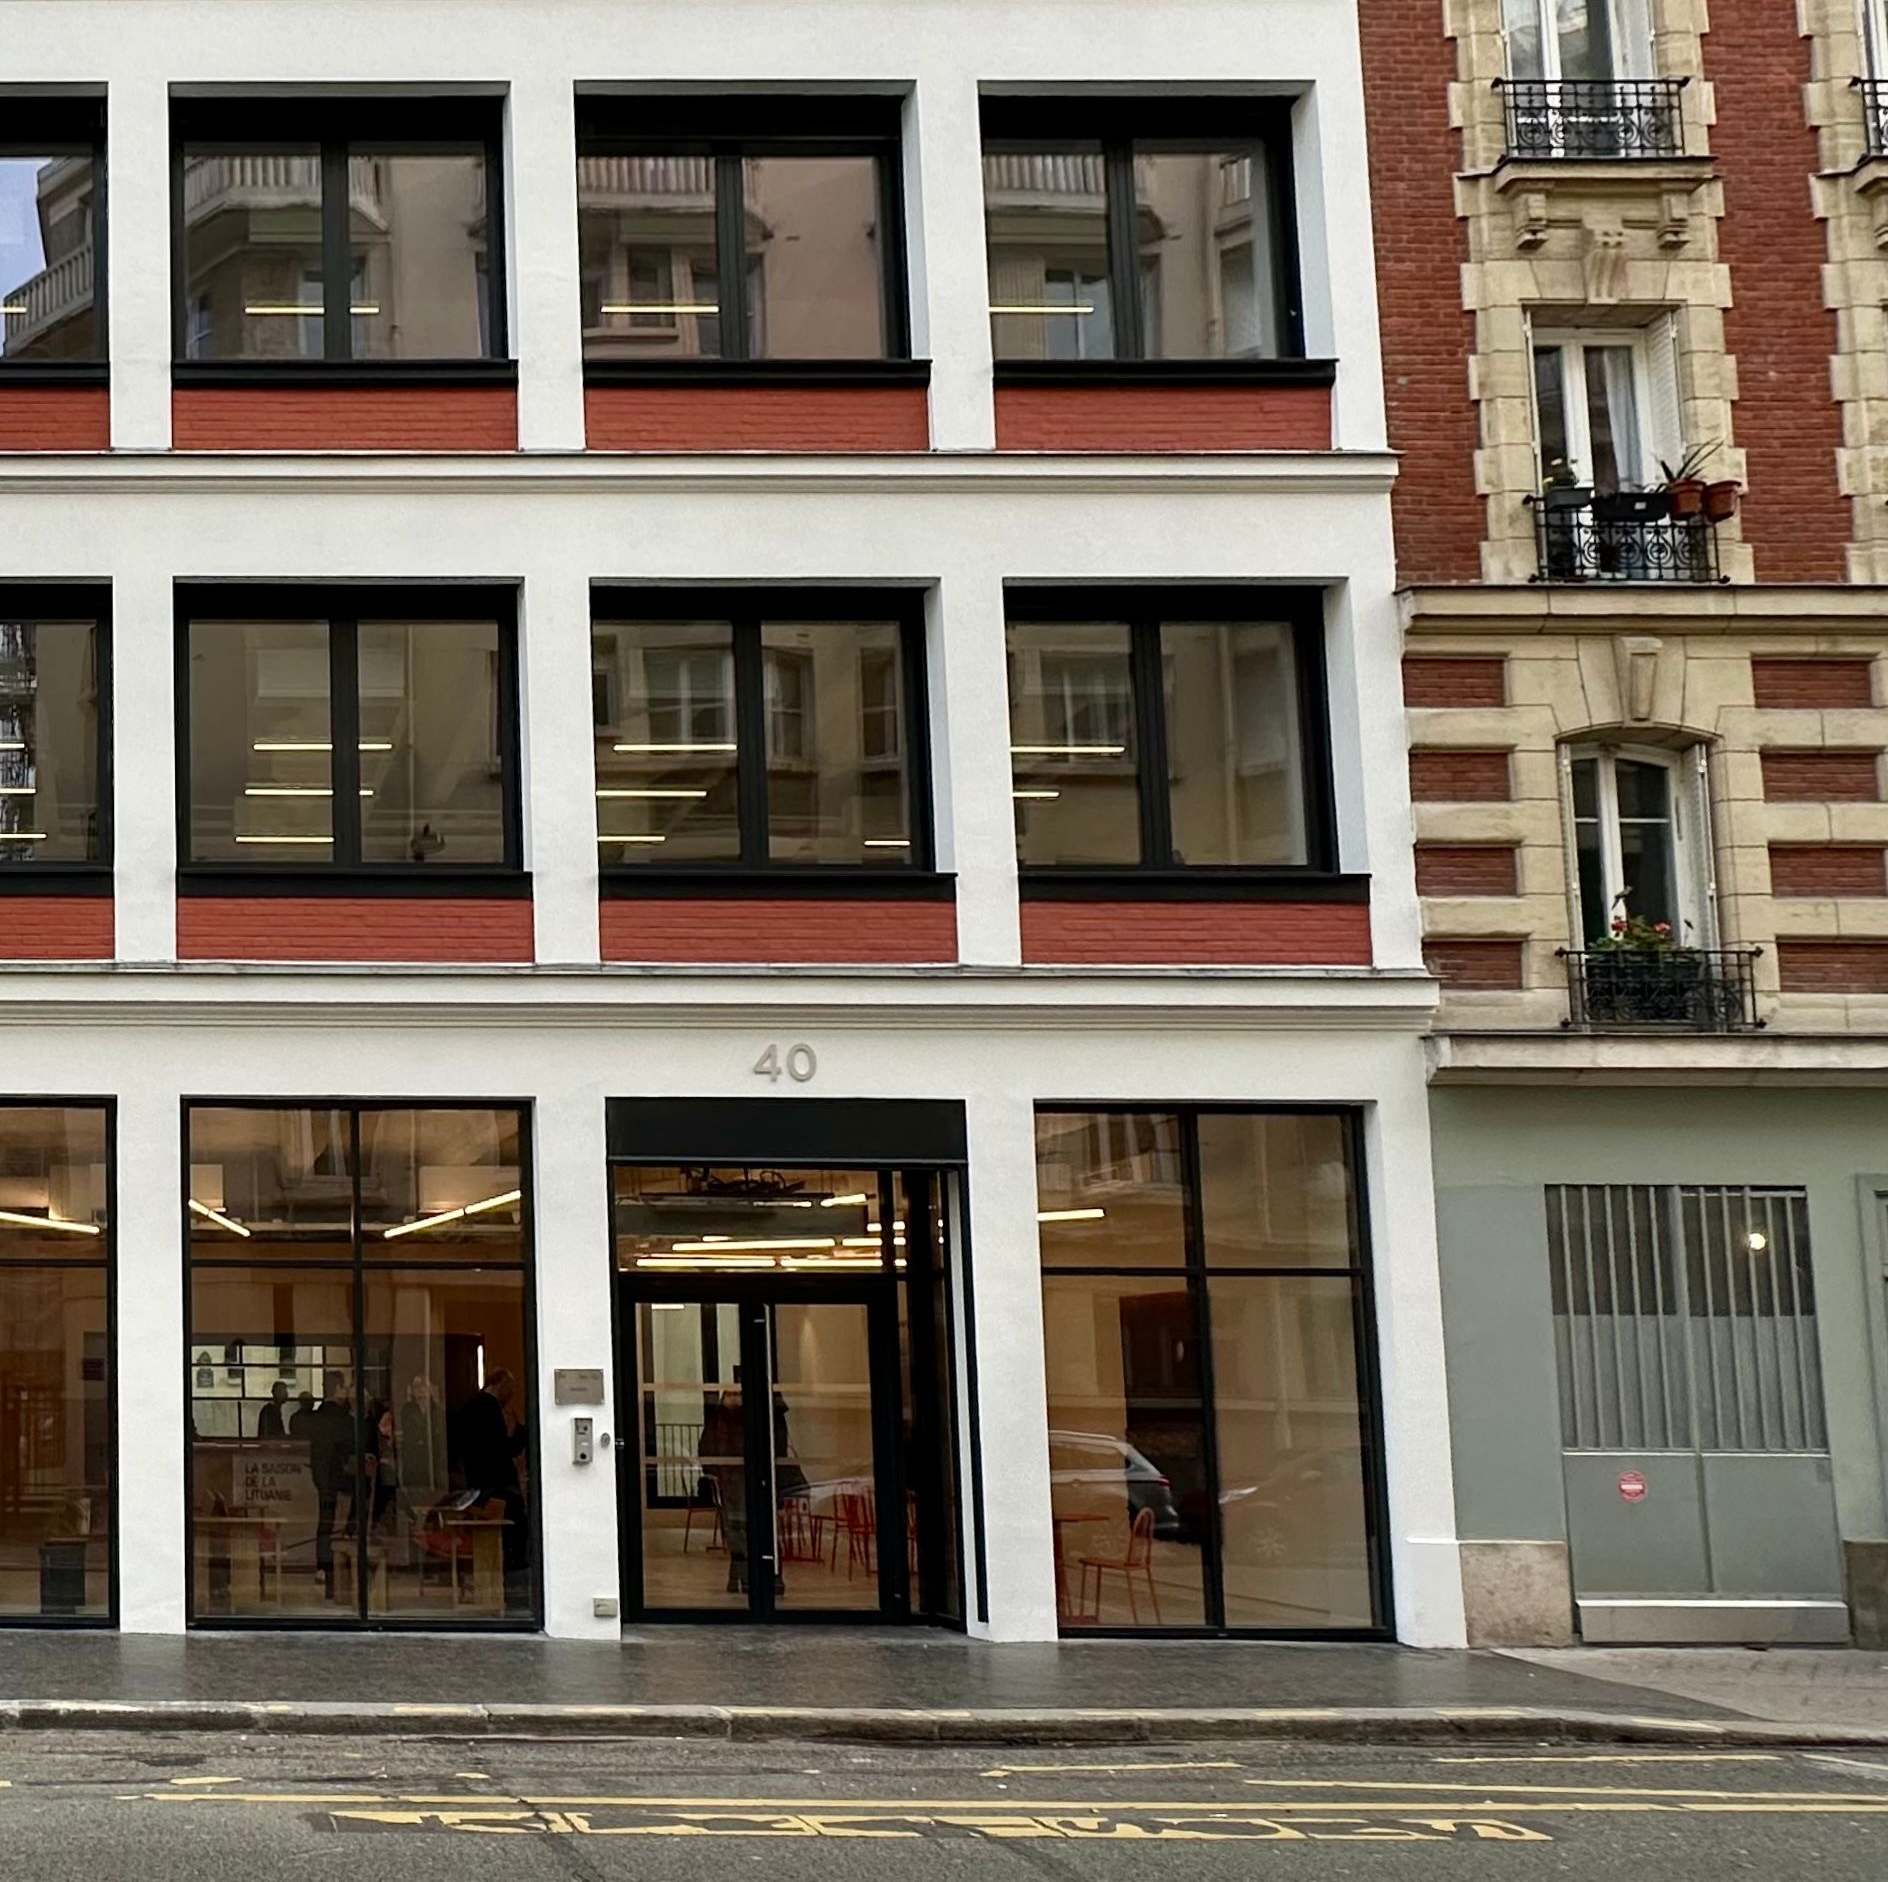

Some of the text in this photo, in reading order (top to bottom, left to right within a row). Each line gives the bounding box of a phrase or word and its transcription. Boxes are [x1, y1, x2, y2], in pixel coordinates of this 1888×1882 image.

[753, 1043, 817, 1082] 40
[245, 1462, 302, 1474] LA SAISON
[245, 1477, 277, 1488] DE LA
